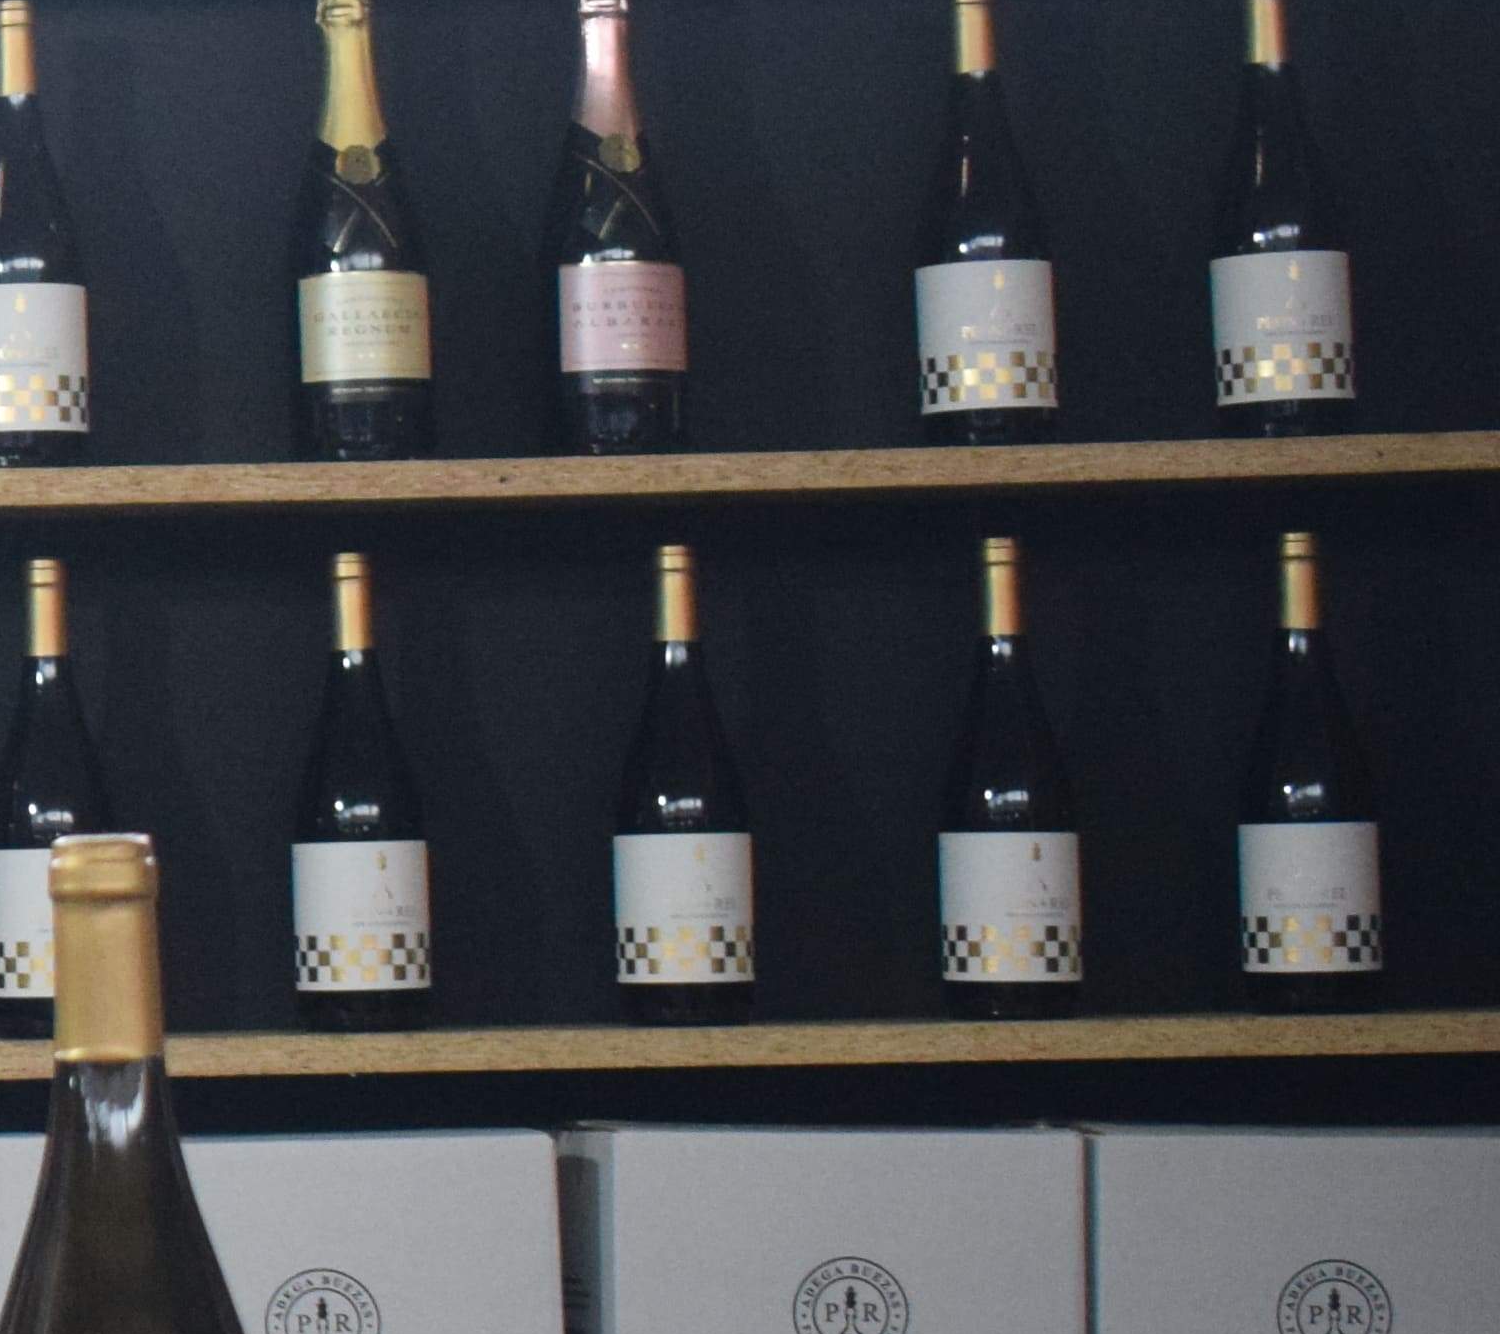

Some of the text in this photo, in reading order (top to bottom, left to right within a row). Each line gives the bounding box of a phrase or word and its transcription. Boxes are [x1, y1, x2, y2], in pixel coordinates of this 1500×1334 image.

[825, 1303, 881, 1322] P R
[1309, 1305, 1364, 1324] P R
[297, 1313, 352, 1334] P R
